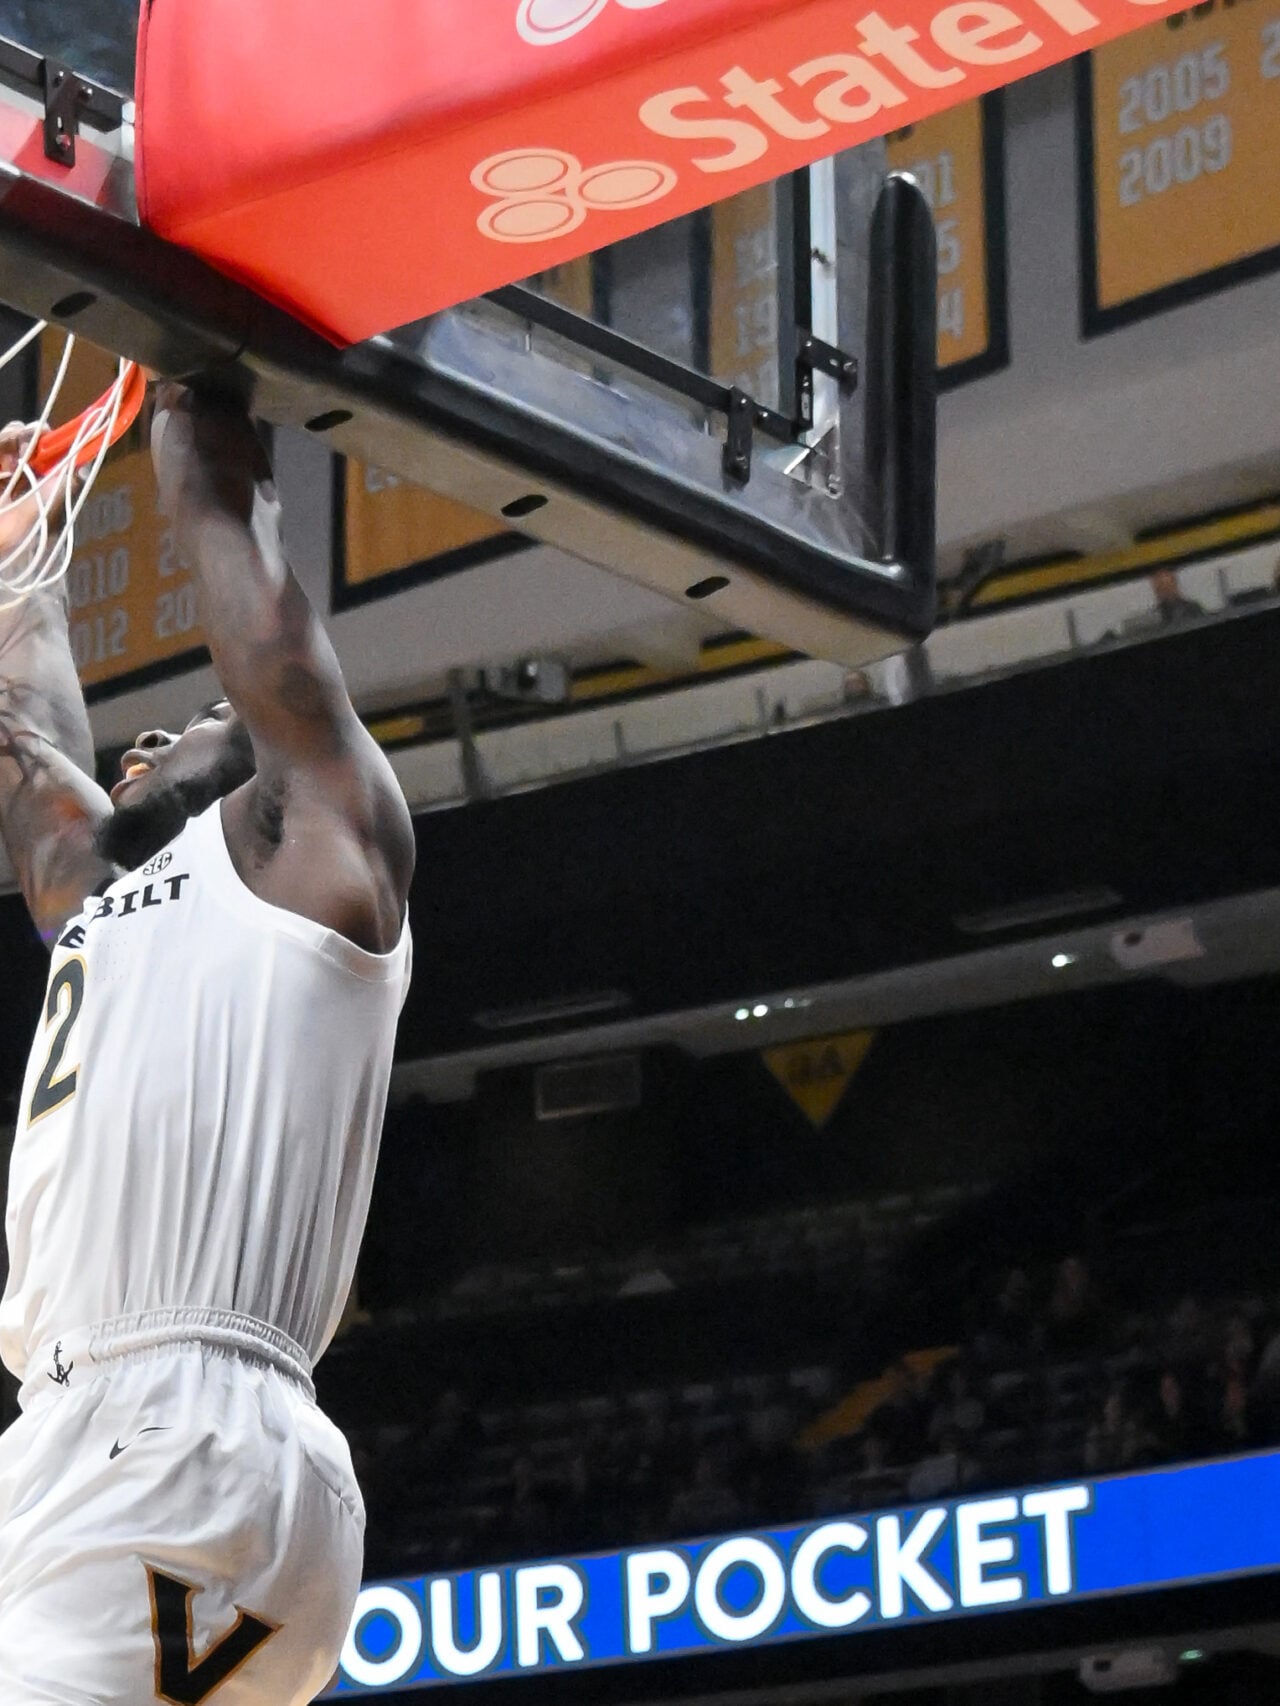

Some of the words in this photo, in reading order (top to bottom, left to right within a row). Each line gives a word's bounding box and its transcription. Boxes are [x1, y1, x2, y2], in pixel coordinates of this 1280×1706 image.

[638, 1, 1044, 173] State
[1118, 40, 1230, 135] 2005
[1118, 113, 1232, 207] 2009
[28, 953, 88, 1129] 2
[138, 1556, 285, 1706] V
[626, 1486, 1090, 1653] POCKET
